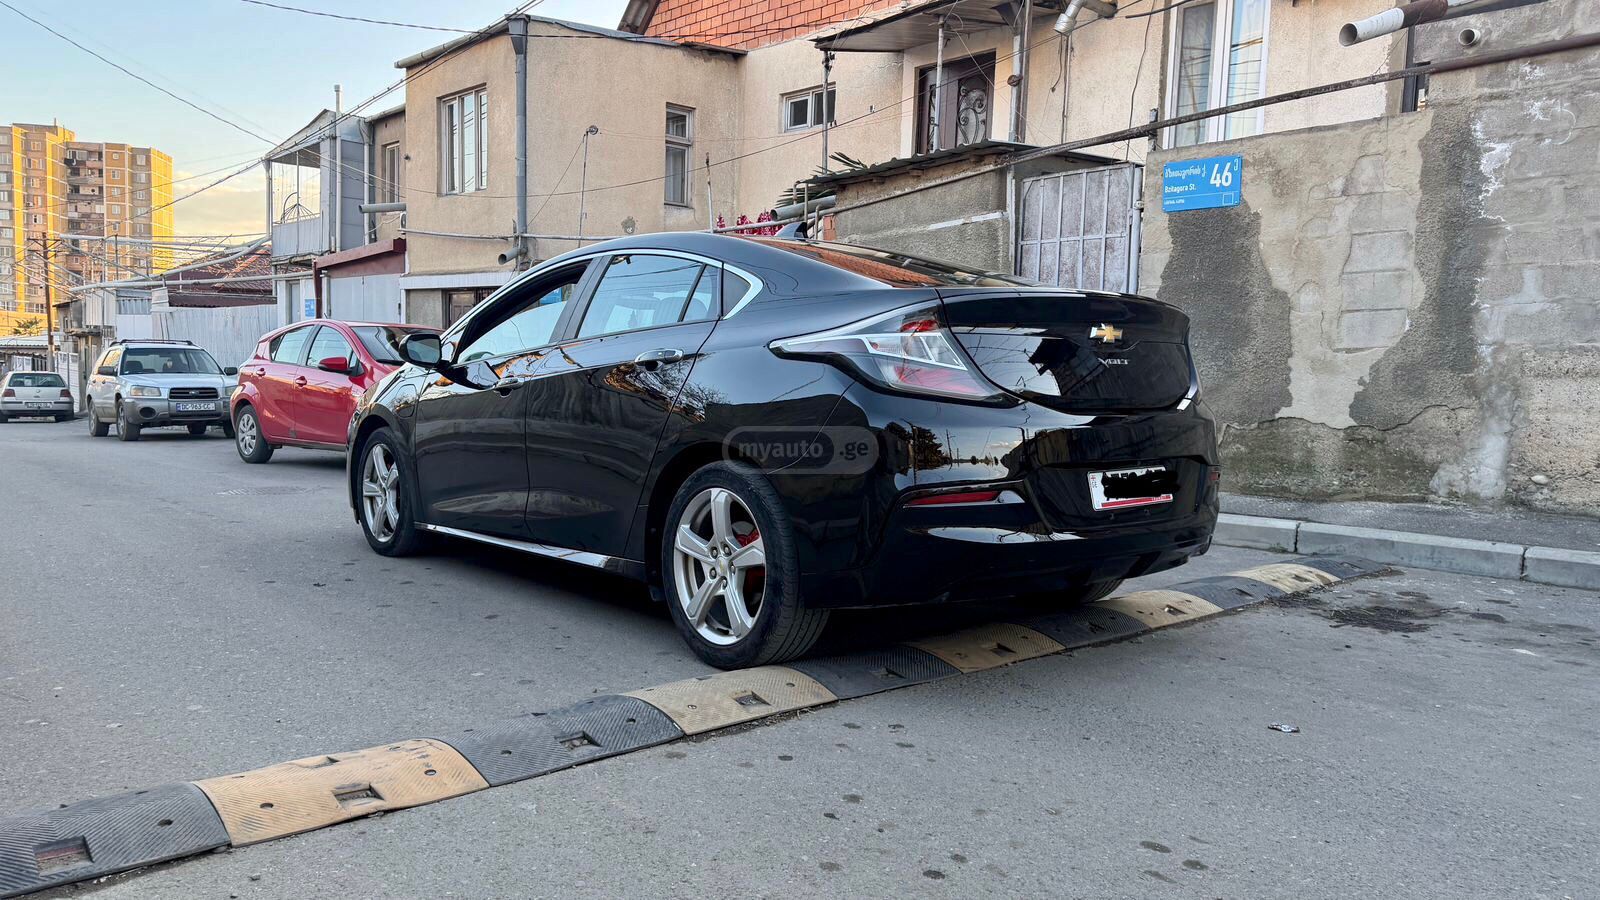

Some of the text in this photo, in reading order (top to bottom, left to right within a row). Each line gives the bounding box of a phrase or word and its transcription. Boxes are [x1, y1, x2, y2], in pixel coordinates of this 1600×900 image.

[1210, 162, 1232, 188] 46
[1165, 183, 1197, 193] Bzitagora St.
